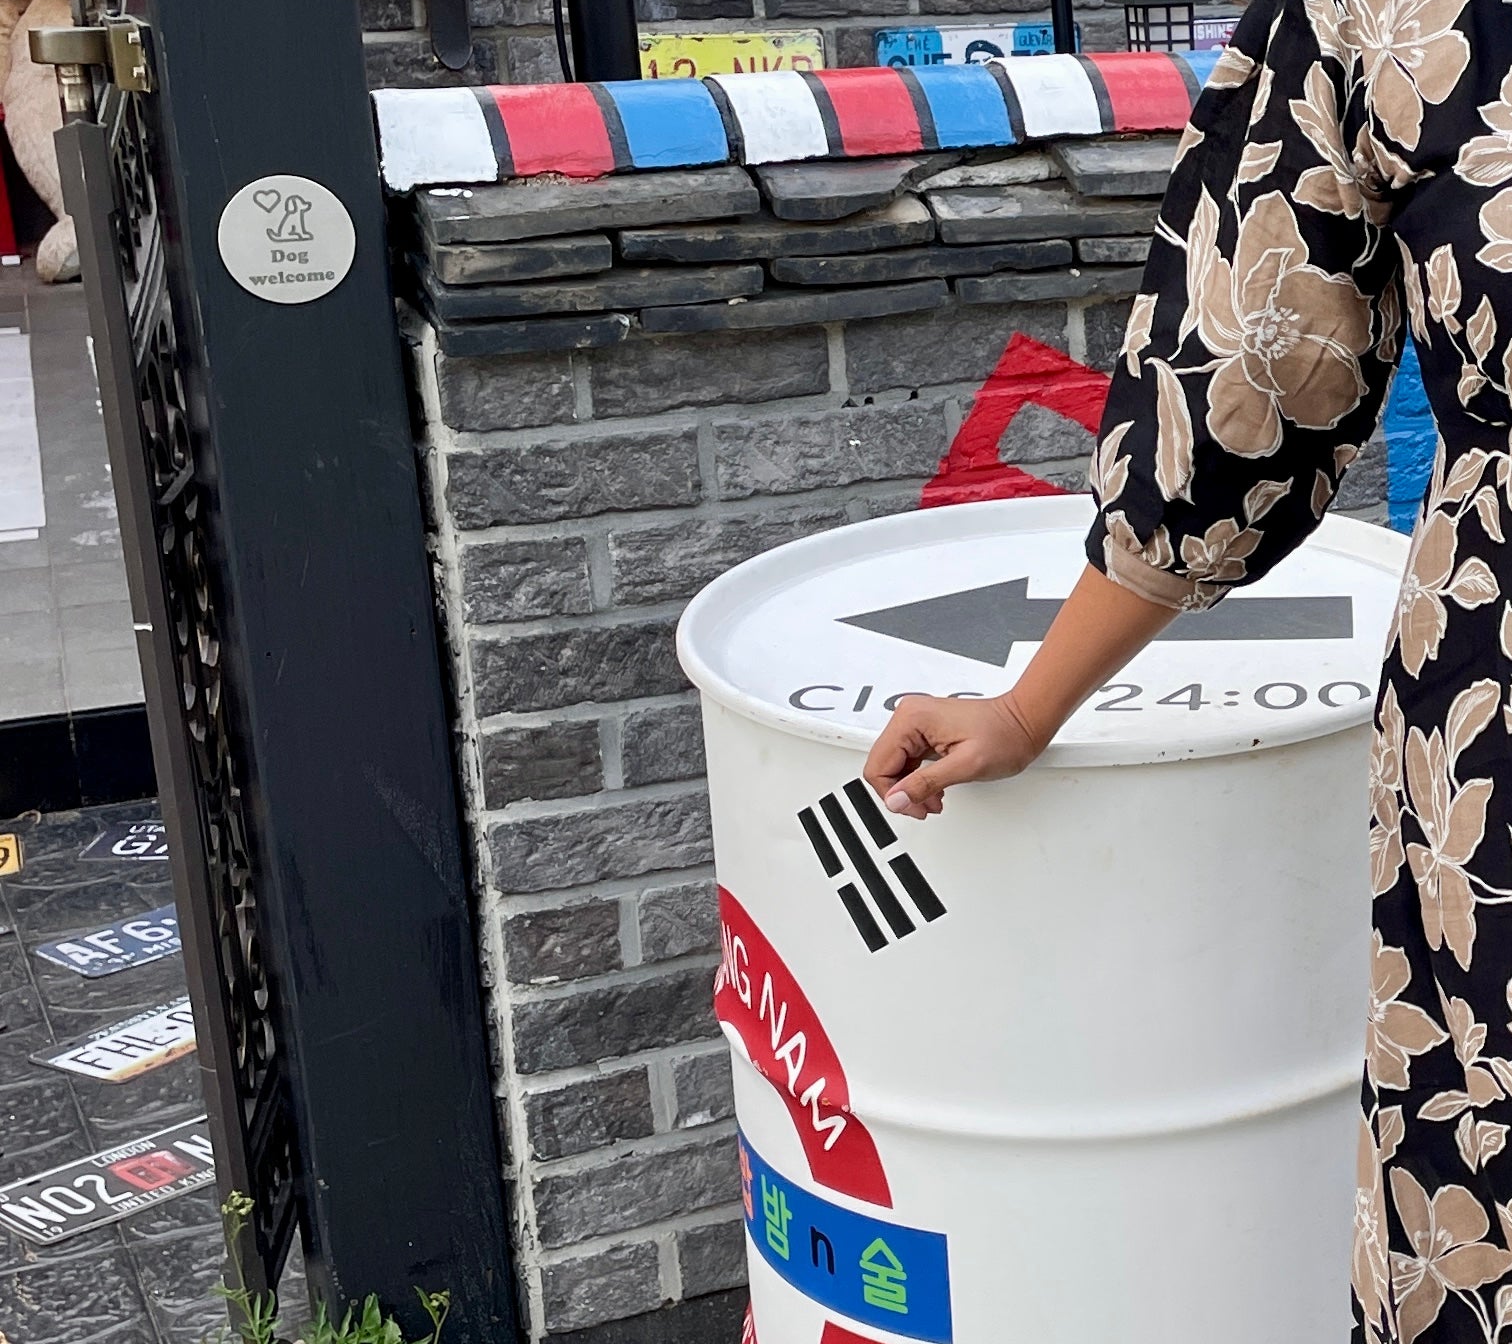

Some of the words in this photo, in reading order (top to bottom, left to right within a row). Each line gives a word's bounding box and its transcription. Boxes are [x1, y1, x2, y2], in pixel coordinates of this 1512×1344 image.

[270, 249, 310, 265] Dog
[248, 270, 336, 287] welcome
[1092, 680, 1374, 713] 24:00
[759, 971, 847, 1151] NAM
[91, 1140, 157, 1168] LONDON
[111, 1185, 176, 1213] UNITED
[858, 1237, 909, 1315] 술
